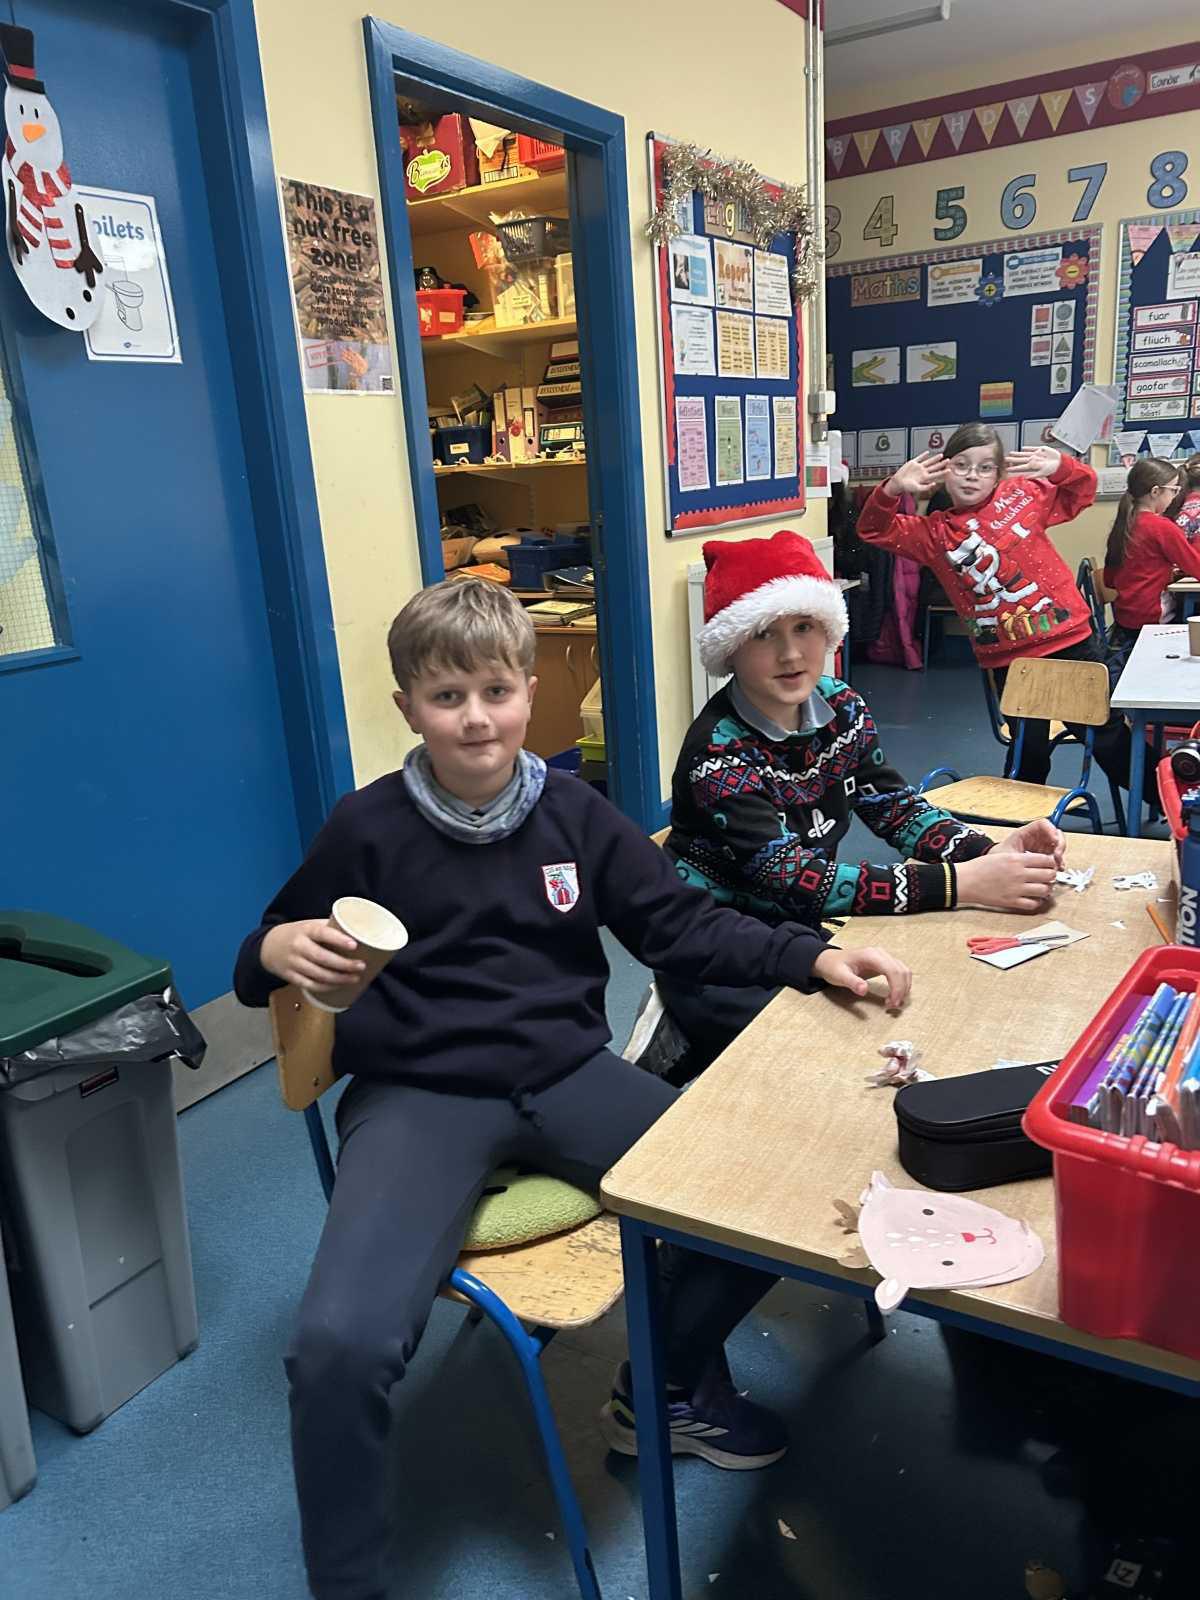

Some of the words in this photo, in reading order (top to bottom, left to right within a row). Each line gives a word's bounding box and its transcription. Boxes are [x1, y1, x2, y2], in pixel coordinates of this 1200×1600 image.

[289, 179, 333, 215] This
[339, 200, 352, 218] is
[359, 205, 370, 222] a
[863, 195, 898, 247] 4
[934, 186, 967, 241] 5
[1000, 174, 1038, 230] 6
[1067, 162, 1108, 222] 7
[1147, 150, 1189, 208] 8
[92, 215, 145, 240] oilets
[294, 217, 327, 240] nut
[332, 218, 372, 249] free
[311, 248, 362, 272] zone!
[853, 275, 920, 302] Maths
[1148, 311, 1170, 321] fuar
[1143, 335, 1170, 345] fliuch
[1136, 381, 1168, 393] gaofar
[931, 434, 941, 447] S
[990, 495, 1034, 530] Christmas
[993, 487, 1025, 513] Merry
